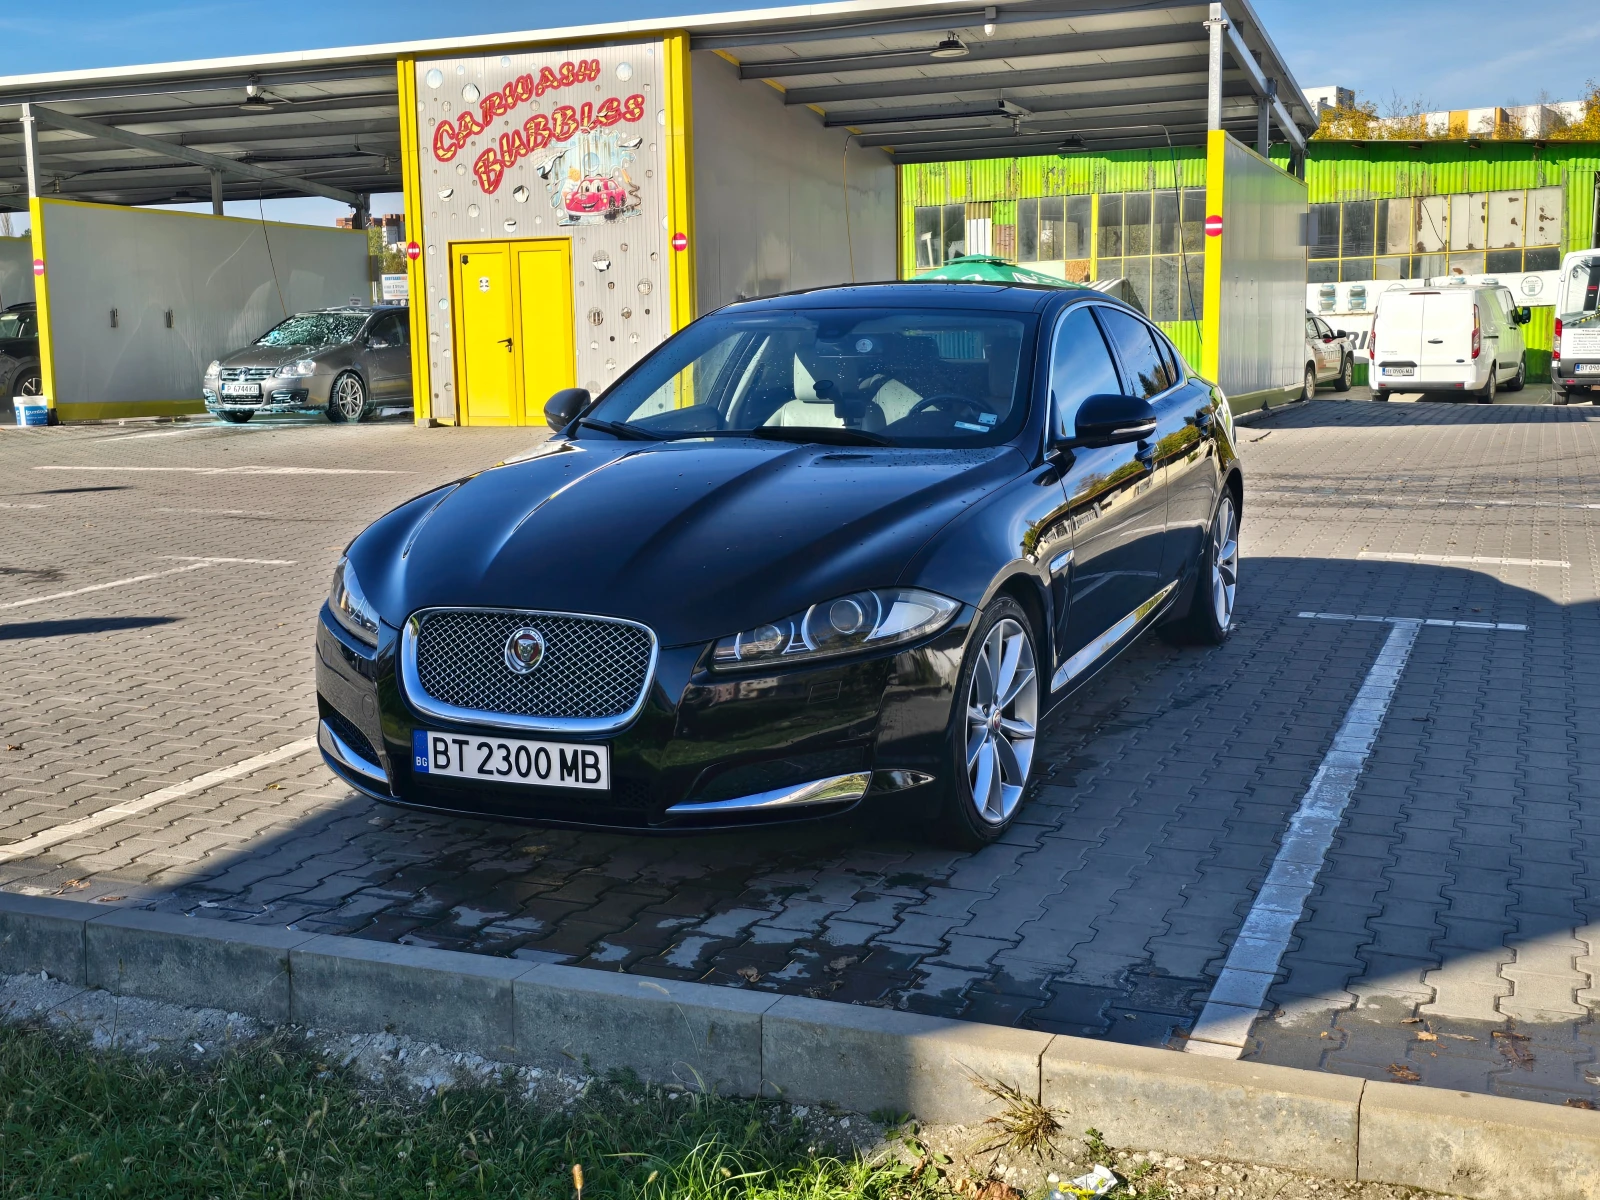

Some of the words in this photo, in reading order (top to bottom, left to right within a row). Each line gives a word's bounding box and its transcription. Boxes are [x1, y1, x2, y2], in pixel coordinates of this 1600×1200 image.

[415, 756, 428, 767] BG
[432, 737, 469, 772] BT
[476, 741, 552, 779] 2300
[559, 748, 601, 784] MB
